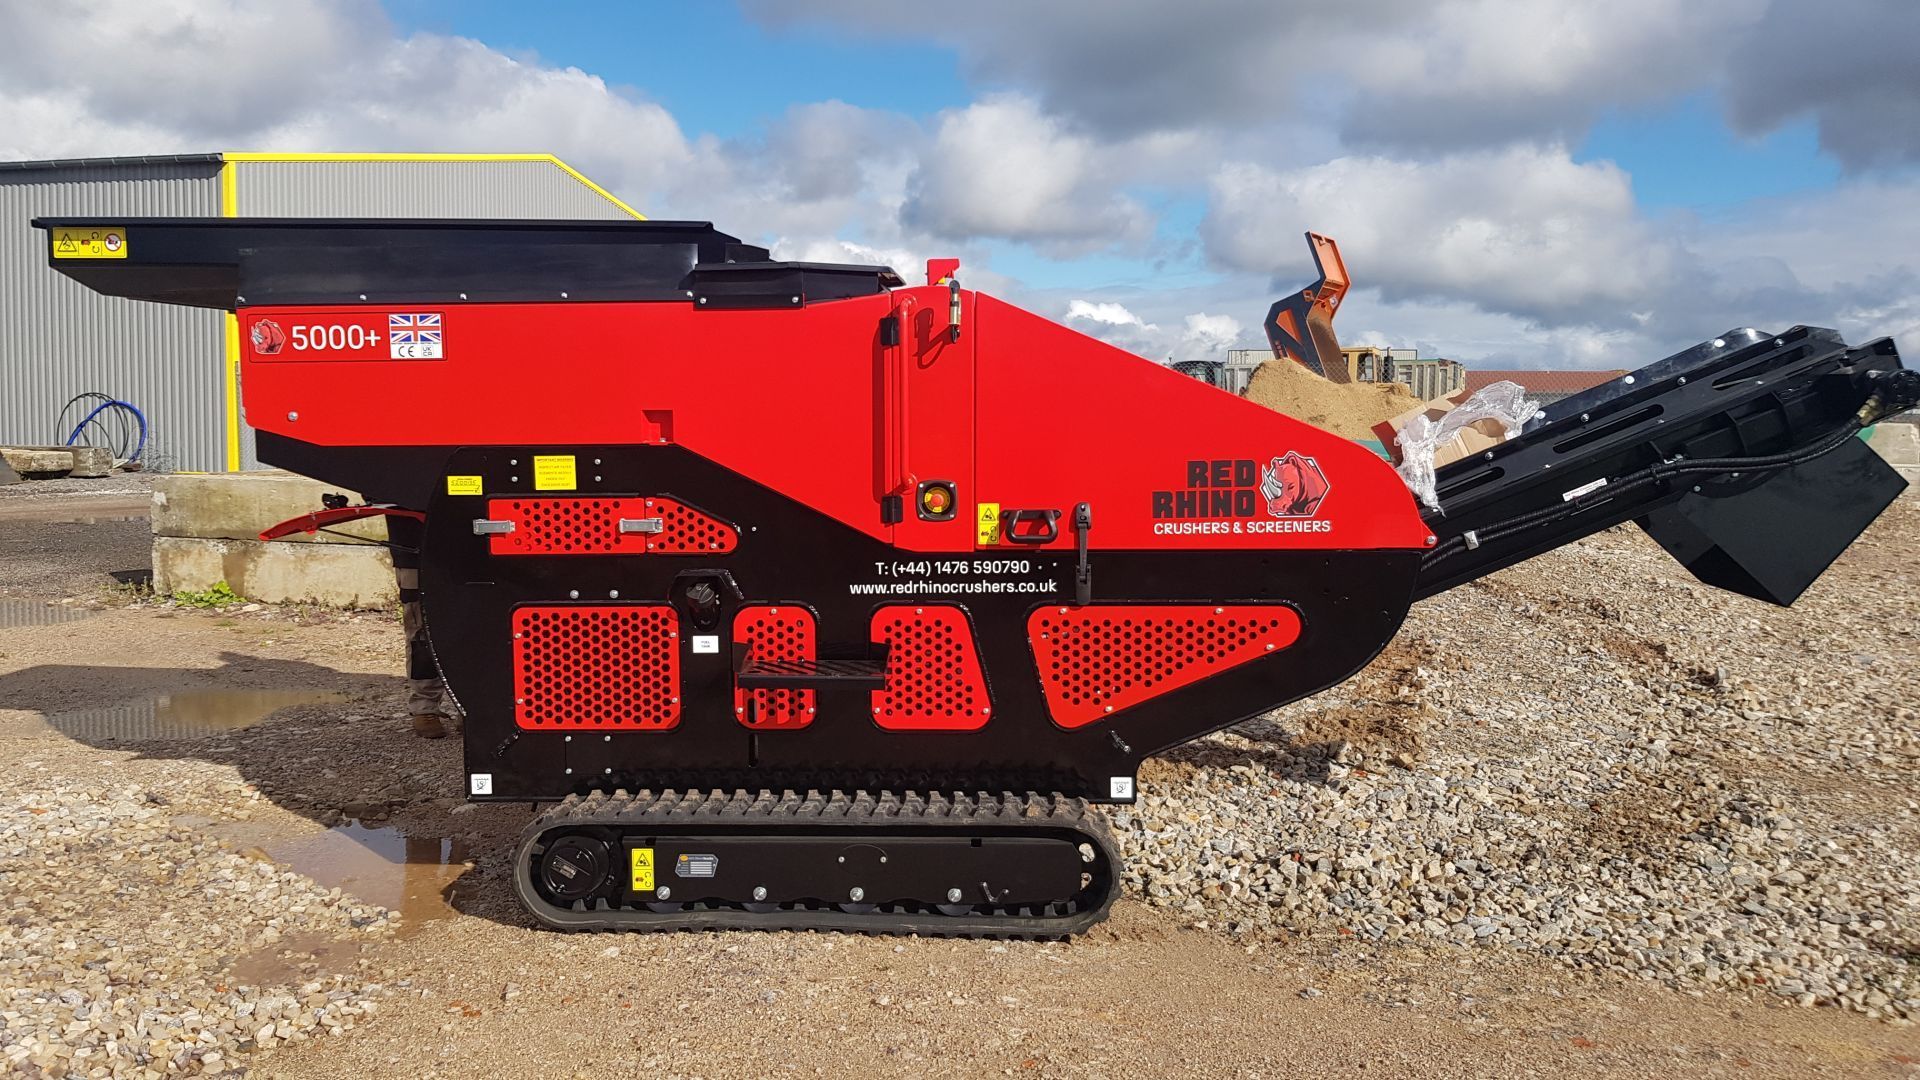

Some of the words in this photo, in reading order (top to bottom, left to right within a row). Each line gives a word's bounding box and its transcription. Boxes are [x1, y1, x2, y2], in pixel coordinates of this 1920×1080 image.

[292, 325, 381, 350] 5000+
[398, 345, 415, 358] CE
[1187, 460, 1256, 488] RED
[1152, 490, 1256, 518] RHINO
[1154, 522, 1230, 535] CRUSHERS
[1233, 521, 1243, 534] &
[1246, 520, 1331, 533] SCREENERS
[875, 562, 888, 575] T:
[892, 561, 932, 577] (+44)
[934, 561, 969, 575] 1476
[973, 560, 1030, 574] 590790
[849, 579, 1057, 595] www.redrhinocrushers.co.uk
